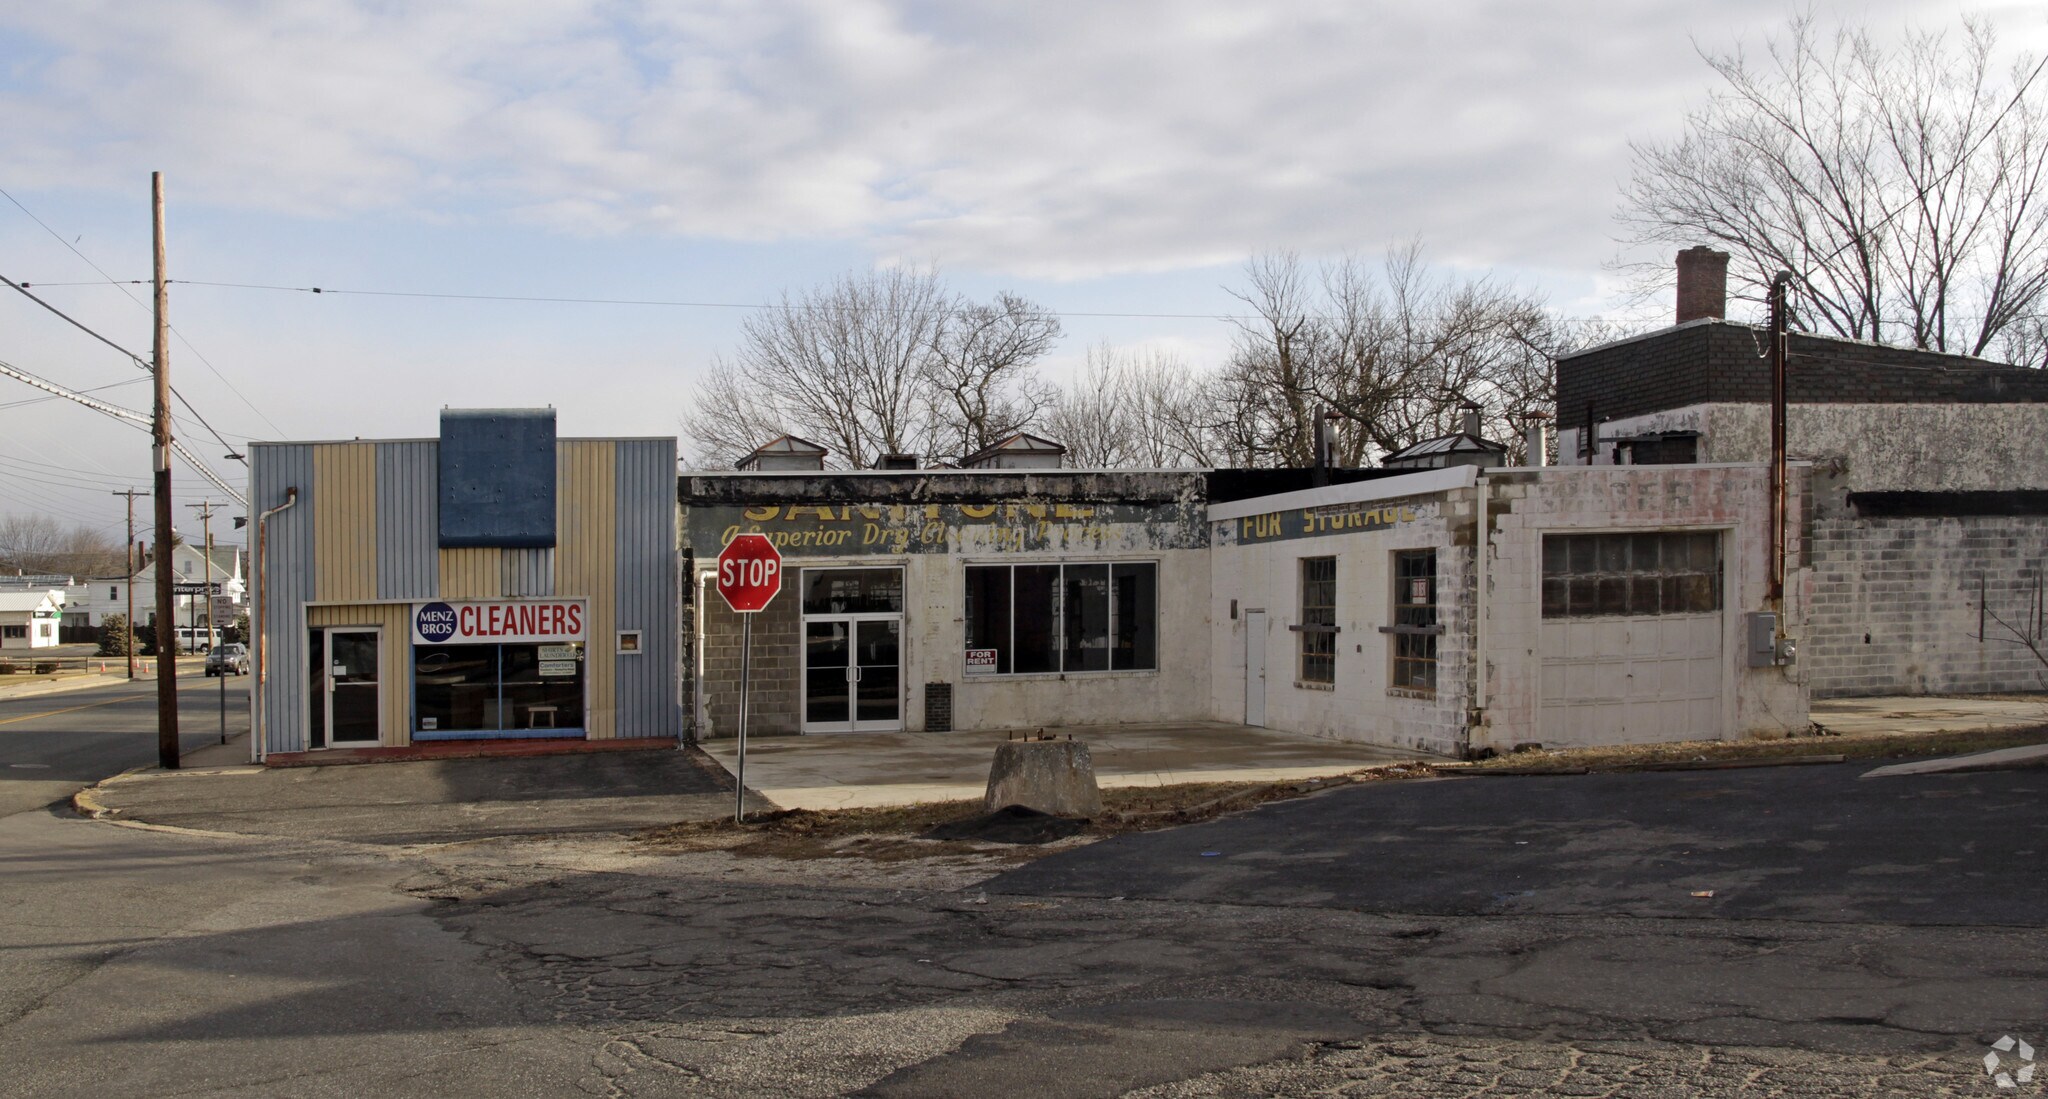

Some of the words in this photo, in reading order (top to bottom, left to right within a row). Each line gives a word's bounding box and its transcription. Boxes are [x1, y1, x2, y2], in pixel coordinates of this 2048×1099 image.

[863, 522, 910, 554] Dry
[1037, 519, 1123, 544] Pocess
[1243, 511, 1282, 539] FOR
[722, 558, 777, 587] STOP
[420, 611, 454, 622] MENZ
[421, 623, 453, 634] BROS
[460, 604, 582, 637] CLEANERS
[967, 657, 995, 665] RENT
